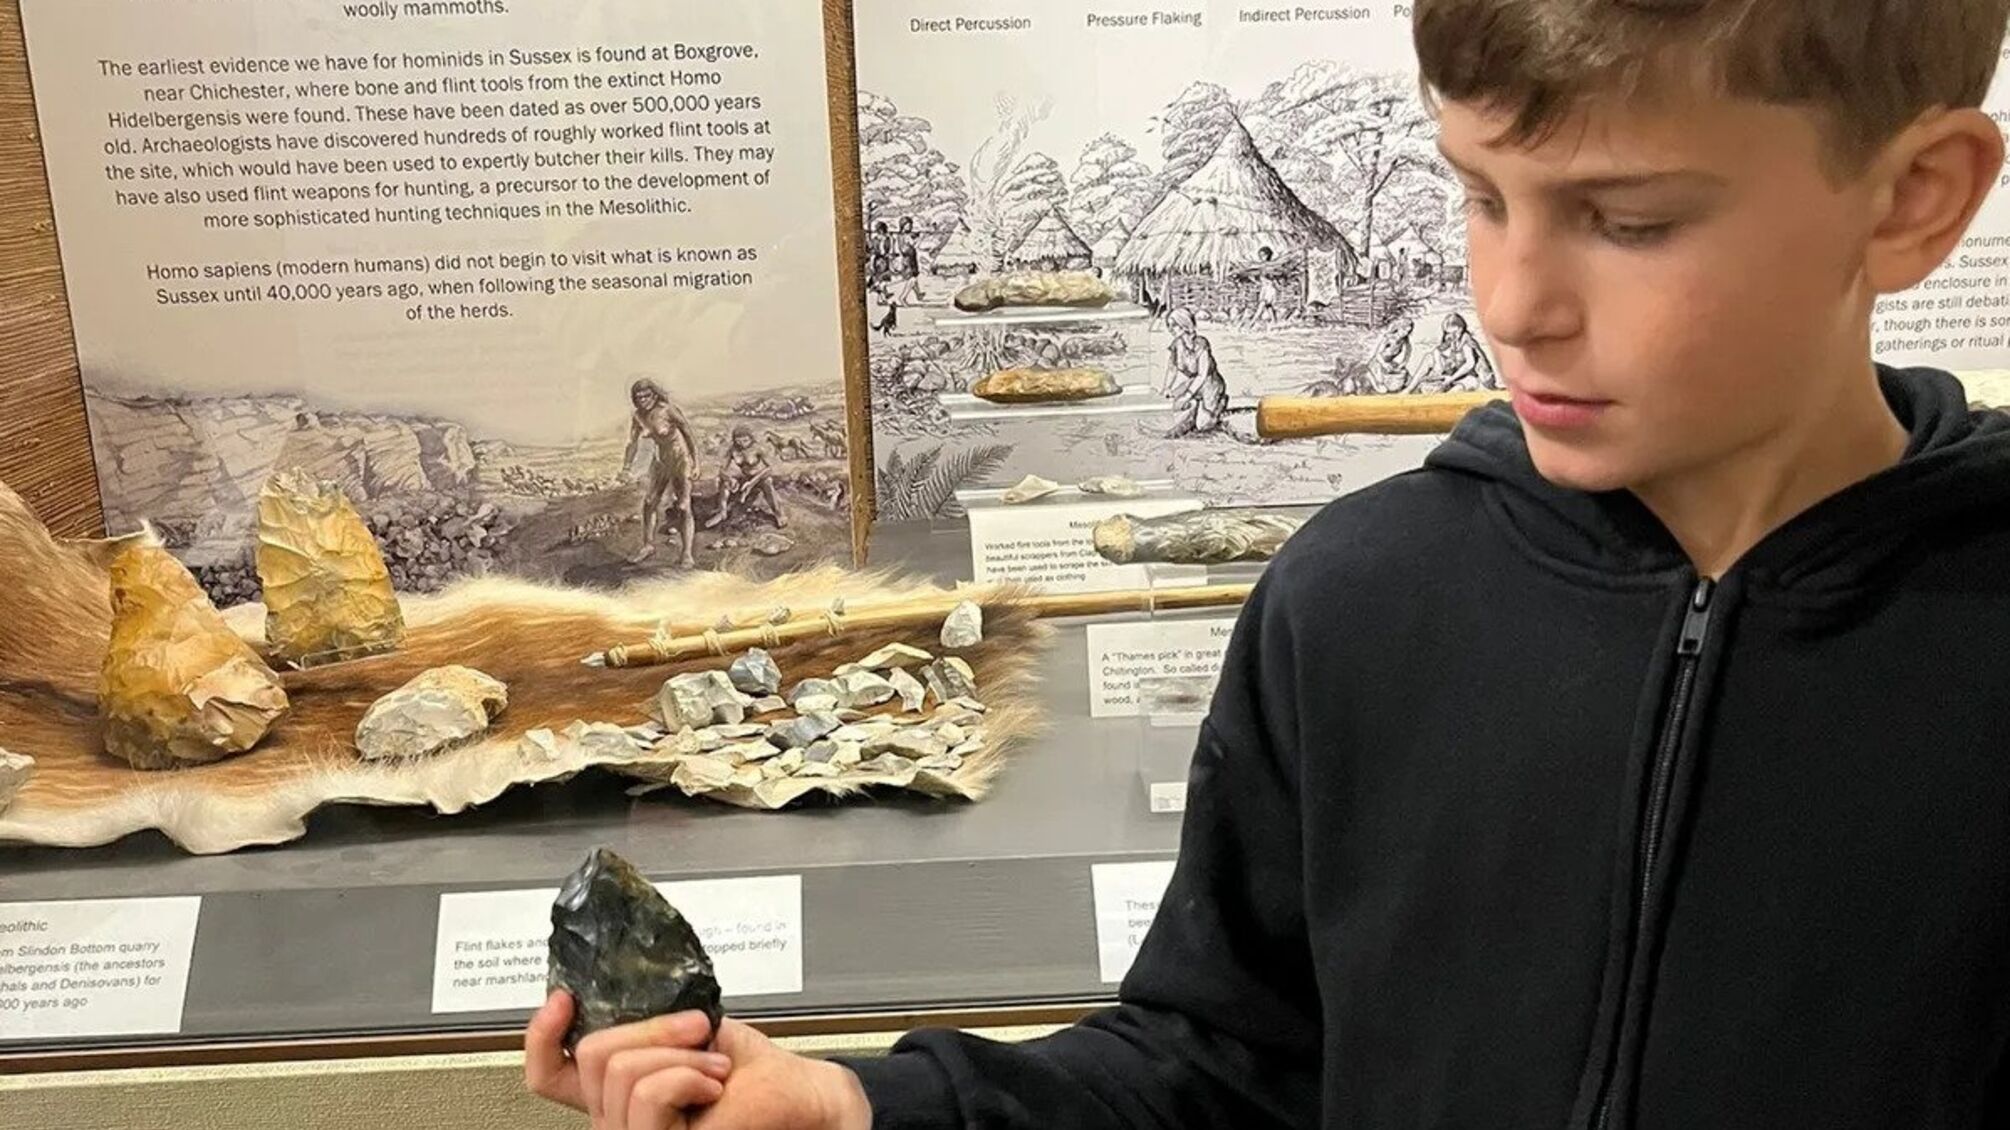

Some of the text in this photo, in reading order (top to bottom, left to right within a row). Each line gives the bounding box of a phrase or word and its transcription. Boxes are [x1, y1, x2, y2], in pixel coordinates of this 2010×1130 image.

[342, 0, 509, 20] woolly mammoths.
[1087, 10, 1202, 27] Pressure Flaking
[1239, 6, 1370, 23] Indirect Percussion
[910, 16, 1031, 32] Direct Percussion
[97, 59, 132, 76] The
[137, 58, 205, 76] earliest
[209, 56, 290, 74] evidence
[294, 57, 320, 72] we
[324, 54, 368, 71] have
[372, 52, 397, 70] for
[402, 50, 484, 69] hominids
[488, 49, 504, 66] in
[508, 48, 572, 66] Sussex
[576, 47, 592, 63] is
[595, 45, 646, 63] found
[651, 46, 669, 61] at
[143, 88, 185, 102] near
[294, 80, 350, 98] where
[354, 80, 399, 96] bone
[404, 77, 437, 95] and
[441, 76, 477, 93] flint
[480, 75, 524, 93] tools
[527, 73, 569, 91] from
[573, 72, 602, 89] the
[607, 70, 666, 88] extinct
[670, 69, 722, 86] Homo
[108, 94, 761, 130] Hidelbergensis were found. These have been dated as over 500,000 years
[103, 119, 771, 155] old. Archaeologists have discovered hundreds of roughly worked flint tools at
[104, 145, 774, 181] the site, which would have been used to expertly butcher their kills. They may
[114, 189, 159, 205] have
[164, 188, 201, 204] also
[205, 186, 249, 204] used
[253, 185, 288, 201] flint
[291, 185, 371, 202] weapons
[374, 181, 399, 198] for
[479, 181, 490, 194] a
[495, 178, 578, 197] precursor
[582, 176, 600, 191] to
[604, 174, 632, 190] the
[636, 171, 750, 190] development
[753, 168, 770, 185] of
[203, 197, 692, 230] more sophisticated hunting techniques in the Mesolithic.
[146, 247, 757, 280] Homo sapiens (modern humans) did not begin to visit what is known as
[1959, 254, 2009, 268] Sussex
[156, 287, 220, 305] Sussex
[222, 285, 262, 303] until
[266, 282, 332, 302] 40,000
[334, 284, 383, 302] years
[427, 279, 474, 295] when
[478, 276, 556, 295] following
[558, 275, 586, 291] the
[591, 271, 668, 290] seasonal
[672, 269, 752, 290] migration
[1924, 277, 1991, 290] enclosure
[1995, 274, 2007, 286] in
[405, 302, 513, 321] of the herds.
[1912, 299, 1934, 310] are
[1937, 296, 1962, 309] still
[1884, 318, 1931, 333] though
[1935, 316, 1971, 329] there
[1975, 315, 1986, 327] is
[1875, 335, 2004, 355] gatherings or ritual
[1196, 649, 1221, 660] great
[1163, 663, 1176, 674] So
[1180, 663, 1208, 673] called
[70, 942, 116, 955] Bottom
[119, 941, 160, 954] quarry
[456, 939, 523, 951] Flint flakes
[74, 958, 165, 973] (the ancestors
[454, 956, 542, 969] the soil where
[31, 975, 162, 991] and Denisovans) for
[452, 977, 482, 987] near
[23, 998, 88, 1012] years ago
